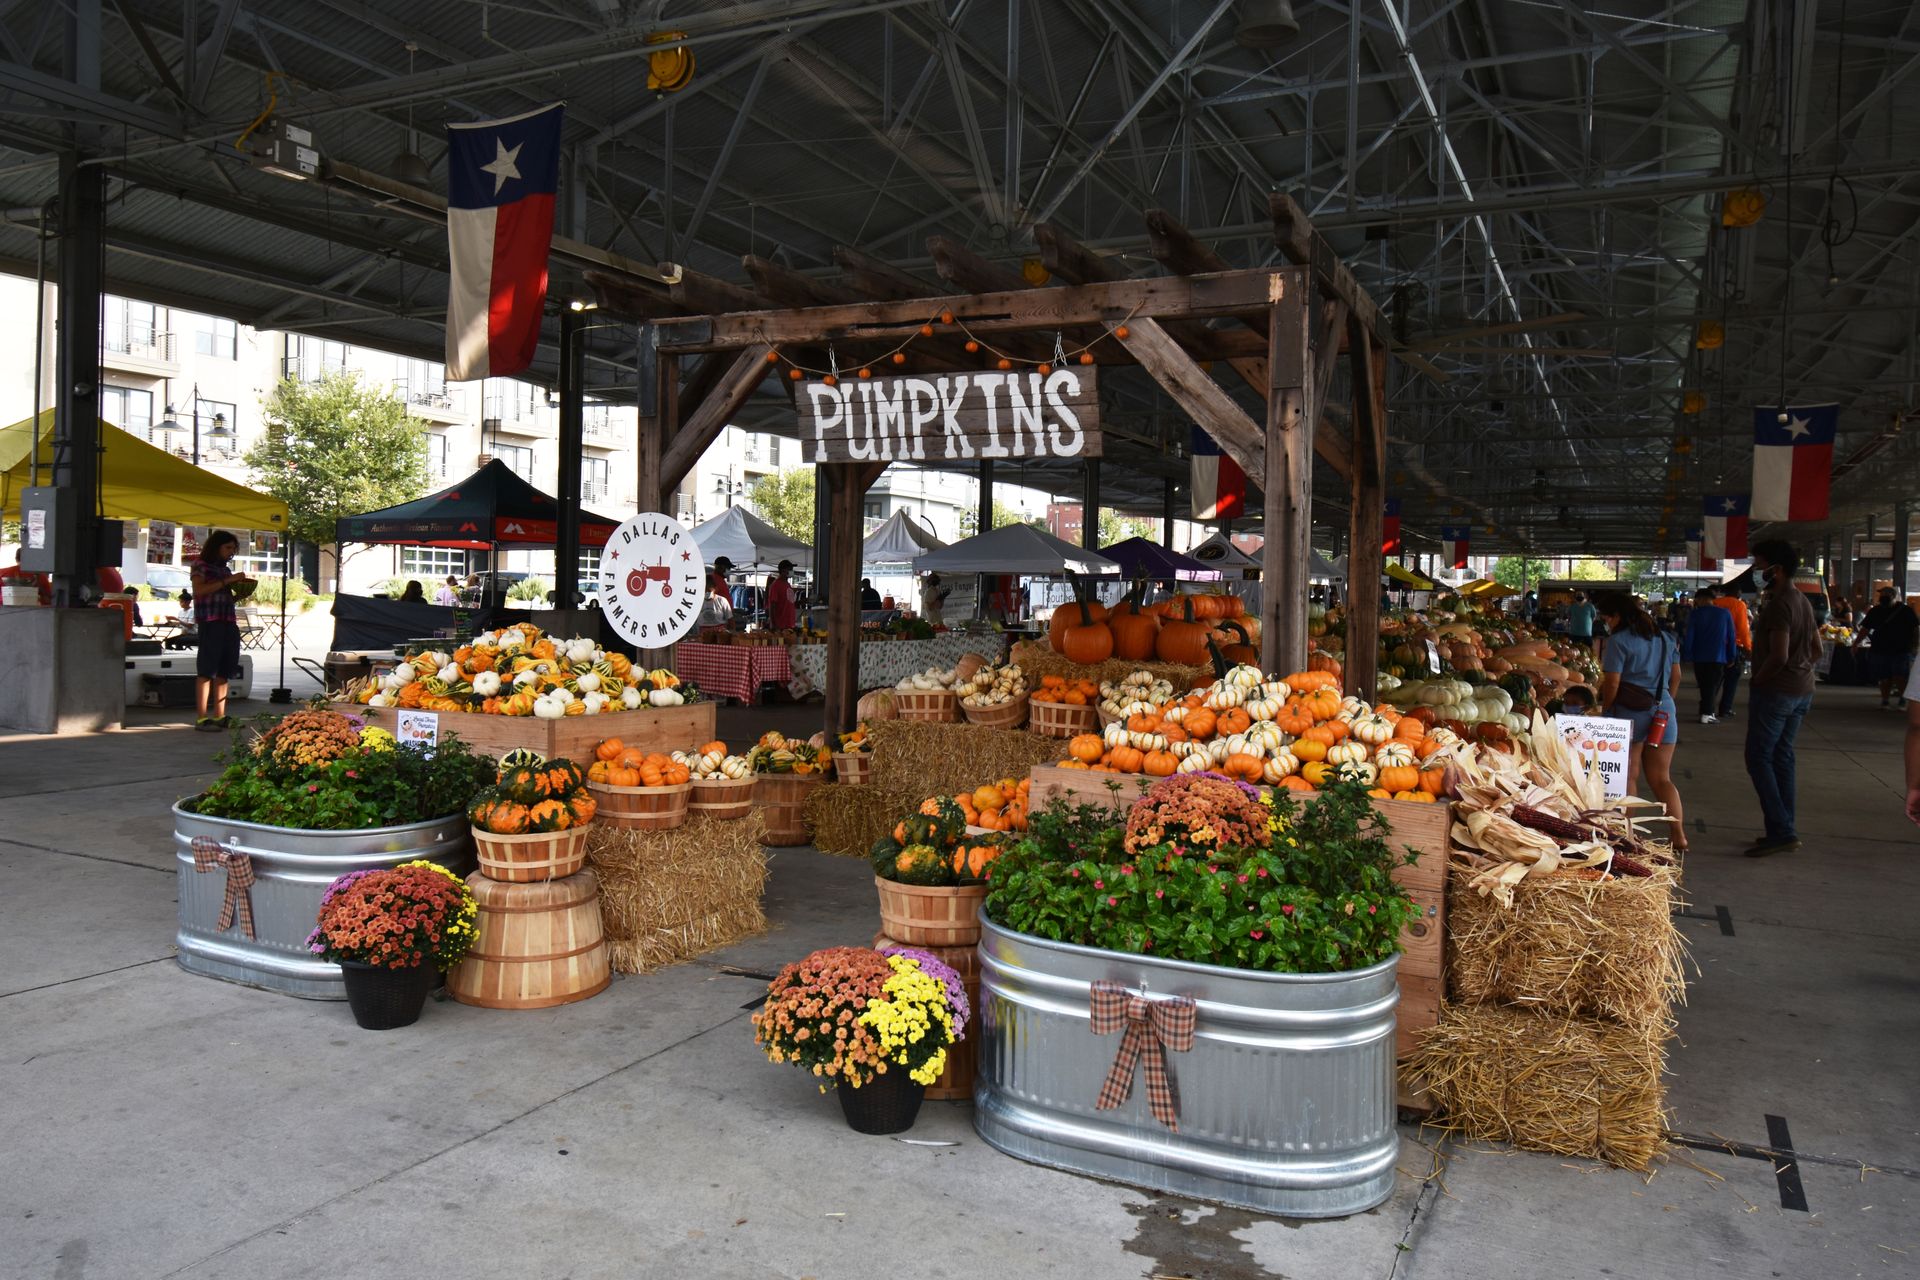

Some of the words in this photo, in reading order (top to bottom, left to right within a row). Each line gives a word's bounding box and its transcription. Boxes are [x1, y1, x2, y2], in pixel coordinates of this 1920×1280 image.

[807, 369, 1084, 462] PUMPKINS
[622, 521, 680, 545] DALLAS
[604, 572, 648, 638] FARMERS
[657, 574, 698, 637] MARKET
[1585, 722, 1605, 731] Local
[1605, 723, 1627, 732] Texas
[1592, 731, 1626, 739] Pumpkins
[1598, 762, 1620, 773] ORN
